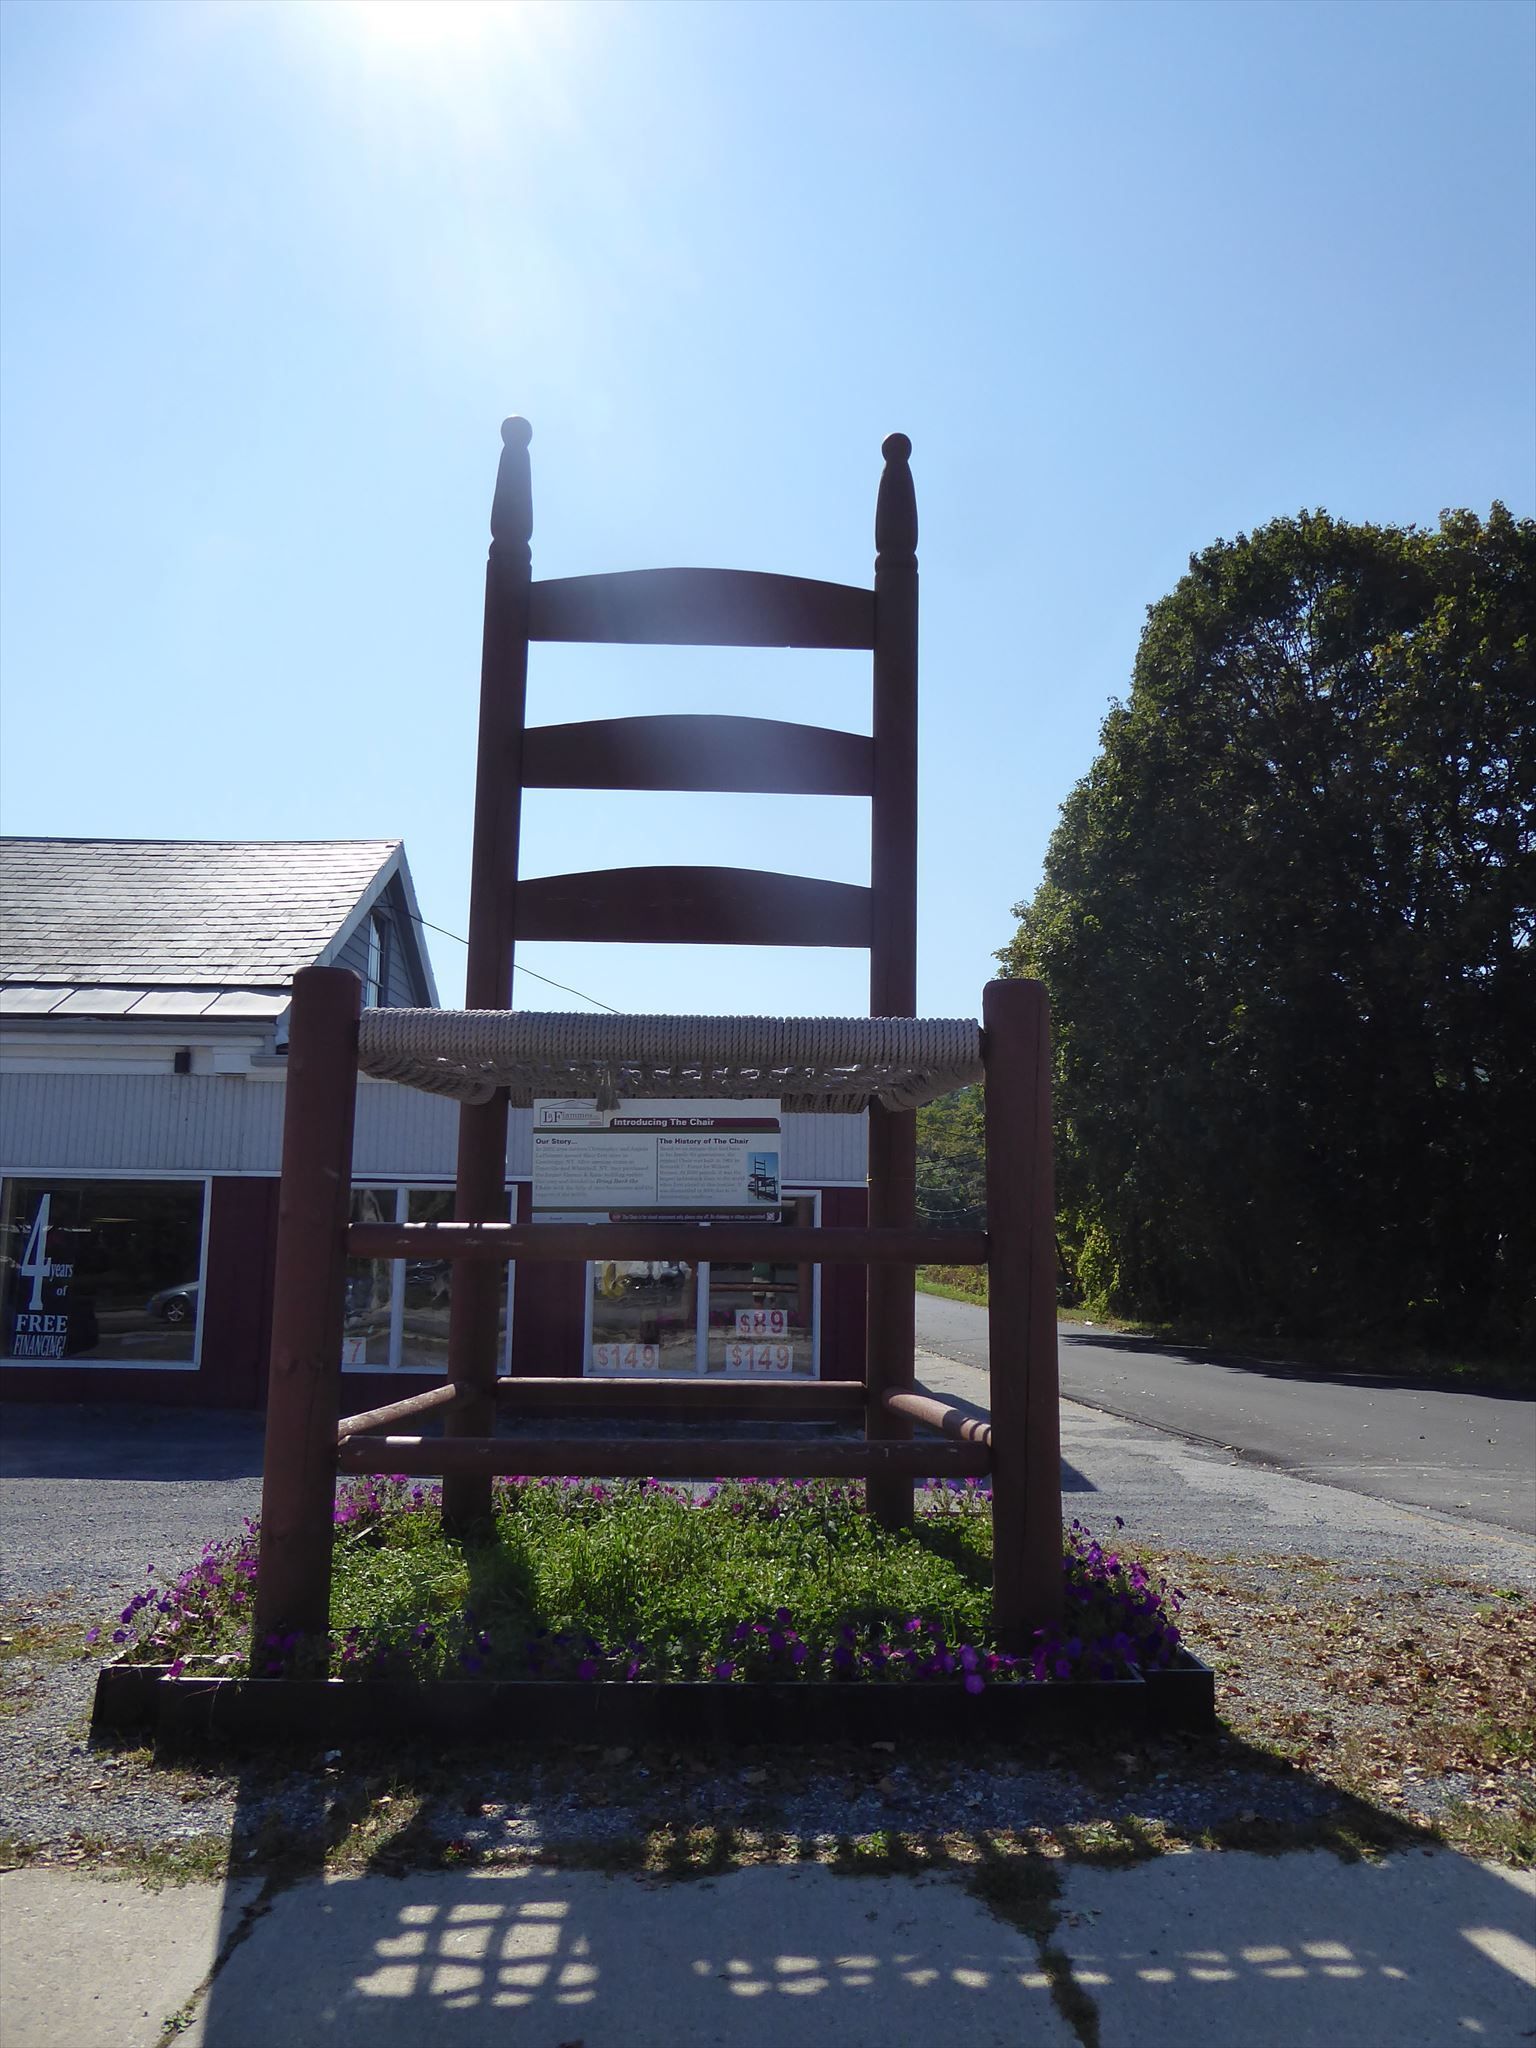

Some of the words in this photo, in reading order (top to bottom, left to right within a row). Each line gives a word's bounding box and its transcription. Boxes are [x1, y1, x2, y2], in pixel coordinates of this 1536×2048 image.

[614, 1118, 667, 1127] Introducing
[670, 1118, 687, 1126] The
[690, 1118, 714, 1126] Chair
[21, 1193, 51, 1311] 4
[50, 1262, 74, 1282] years
[56, 1285, 68, 1297] of
[16, 1314, 68, 1333] FREE
[740, 1311, 784, 1334] $89
[13, 1335, 67, 1359] FINANCING!
[598, 1345, 656, 1367] $149
[731, 1345, 790, 1370] $149
